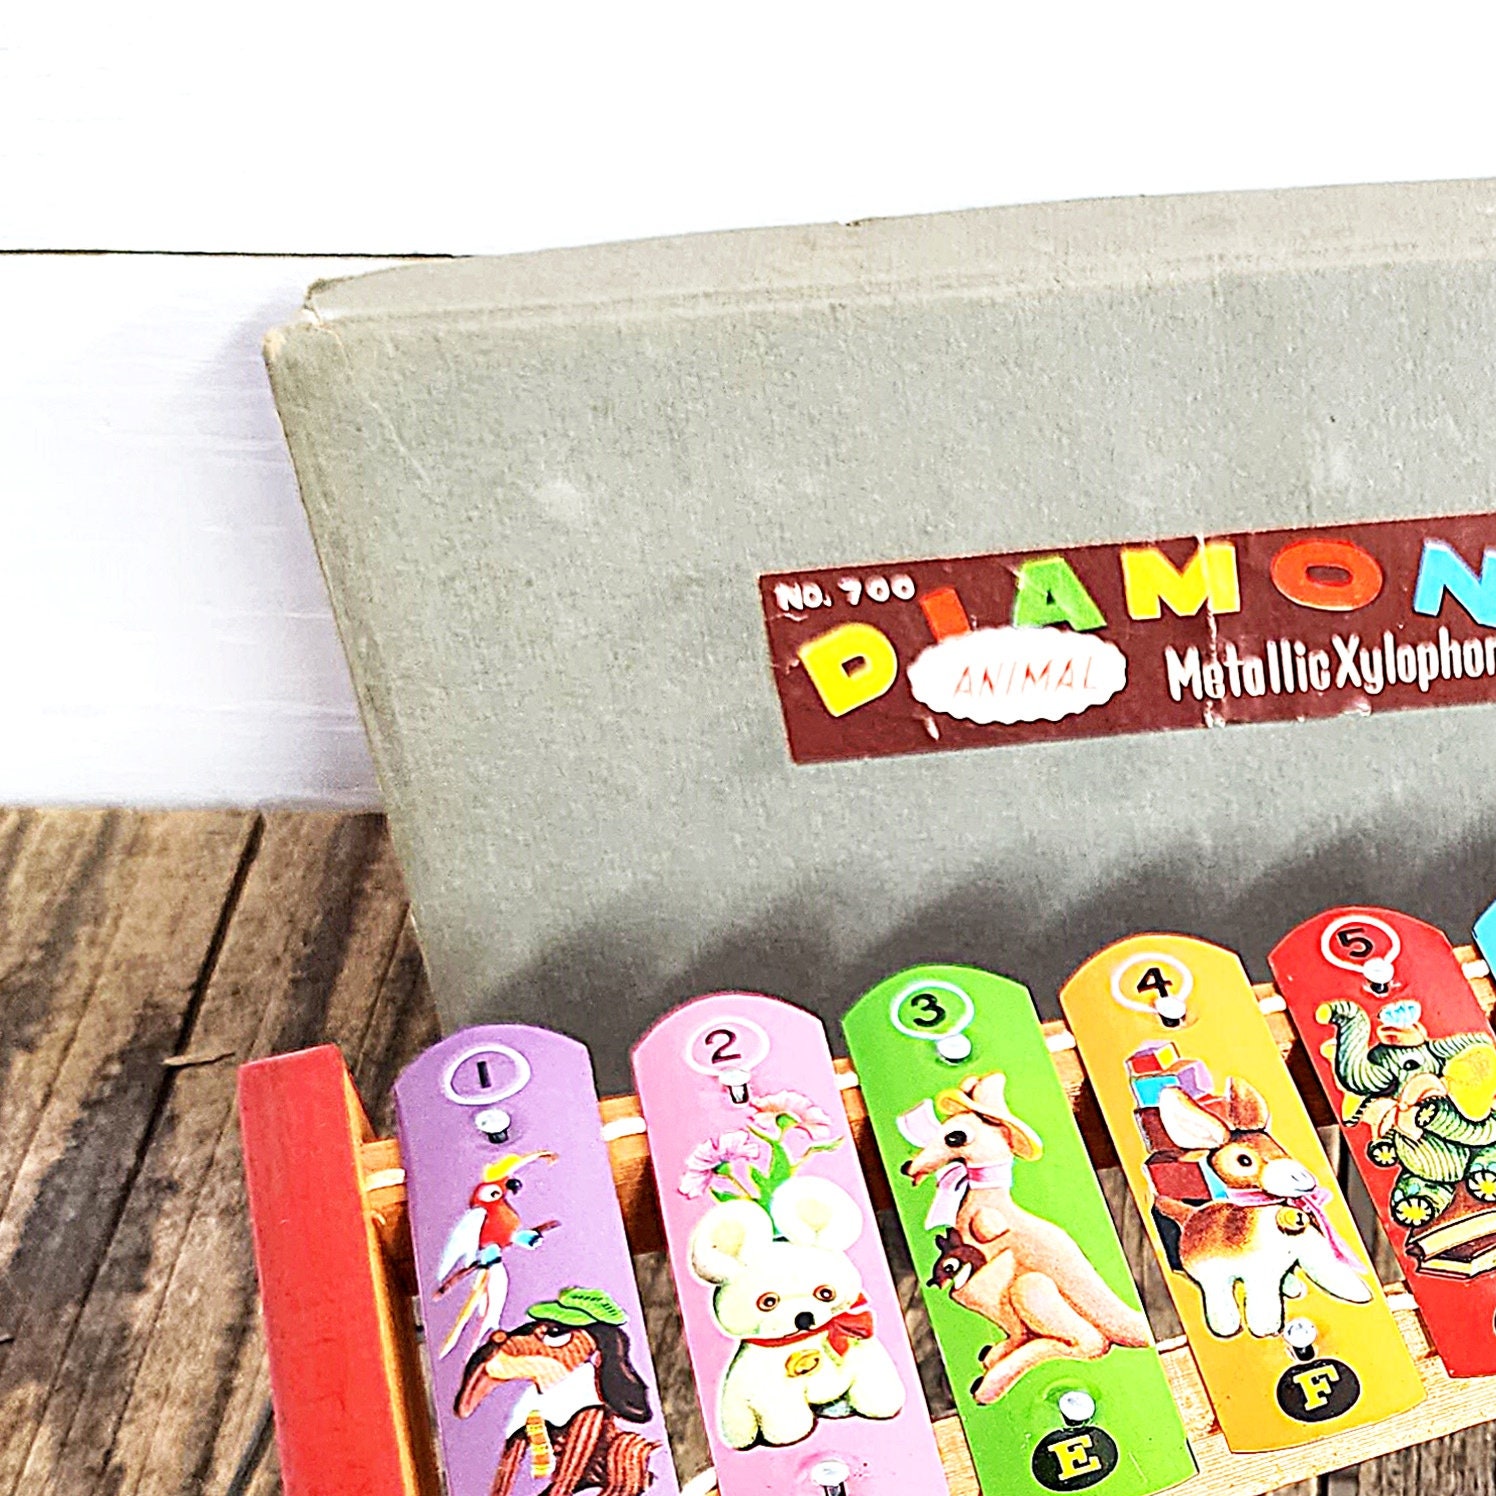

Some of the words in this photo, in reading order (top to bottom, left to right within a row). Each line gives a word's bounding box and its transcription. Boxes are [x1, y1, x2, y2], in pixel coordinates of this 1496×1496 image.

[837, 573, 915, 606] 700
[953, 656, 1098, 698] ANIMAL
[1336, 930, 1374, 960] 5
[1139, 968, 1174, 999] 4
[910, 993, 947, 1027] 3
[704, 1029, 741, 1063] 2
[1295, 1368, 1339, 1411] F
[1053, 1435, 1102, 1481] E
